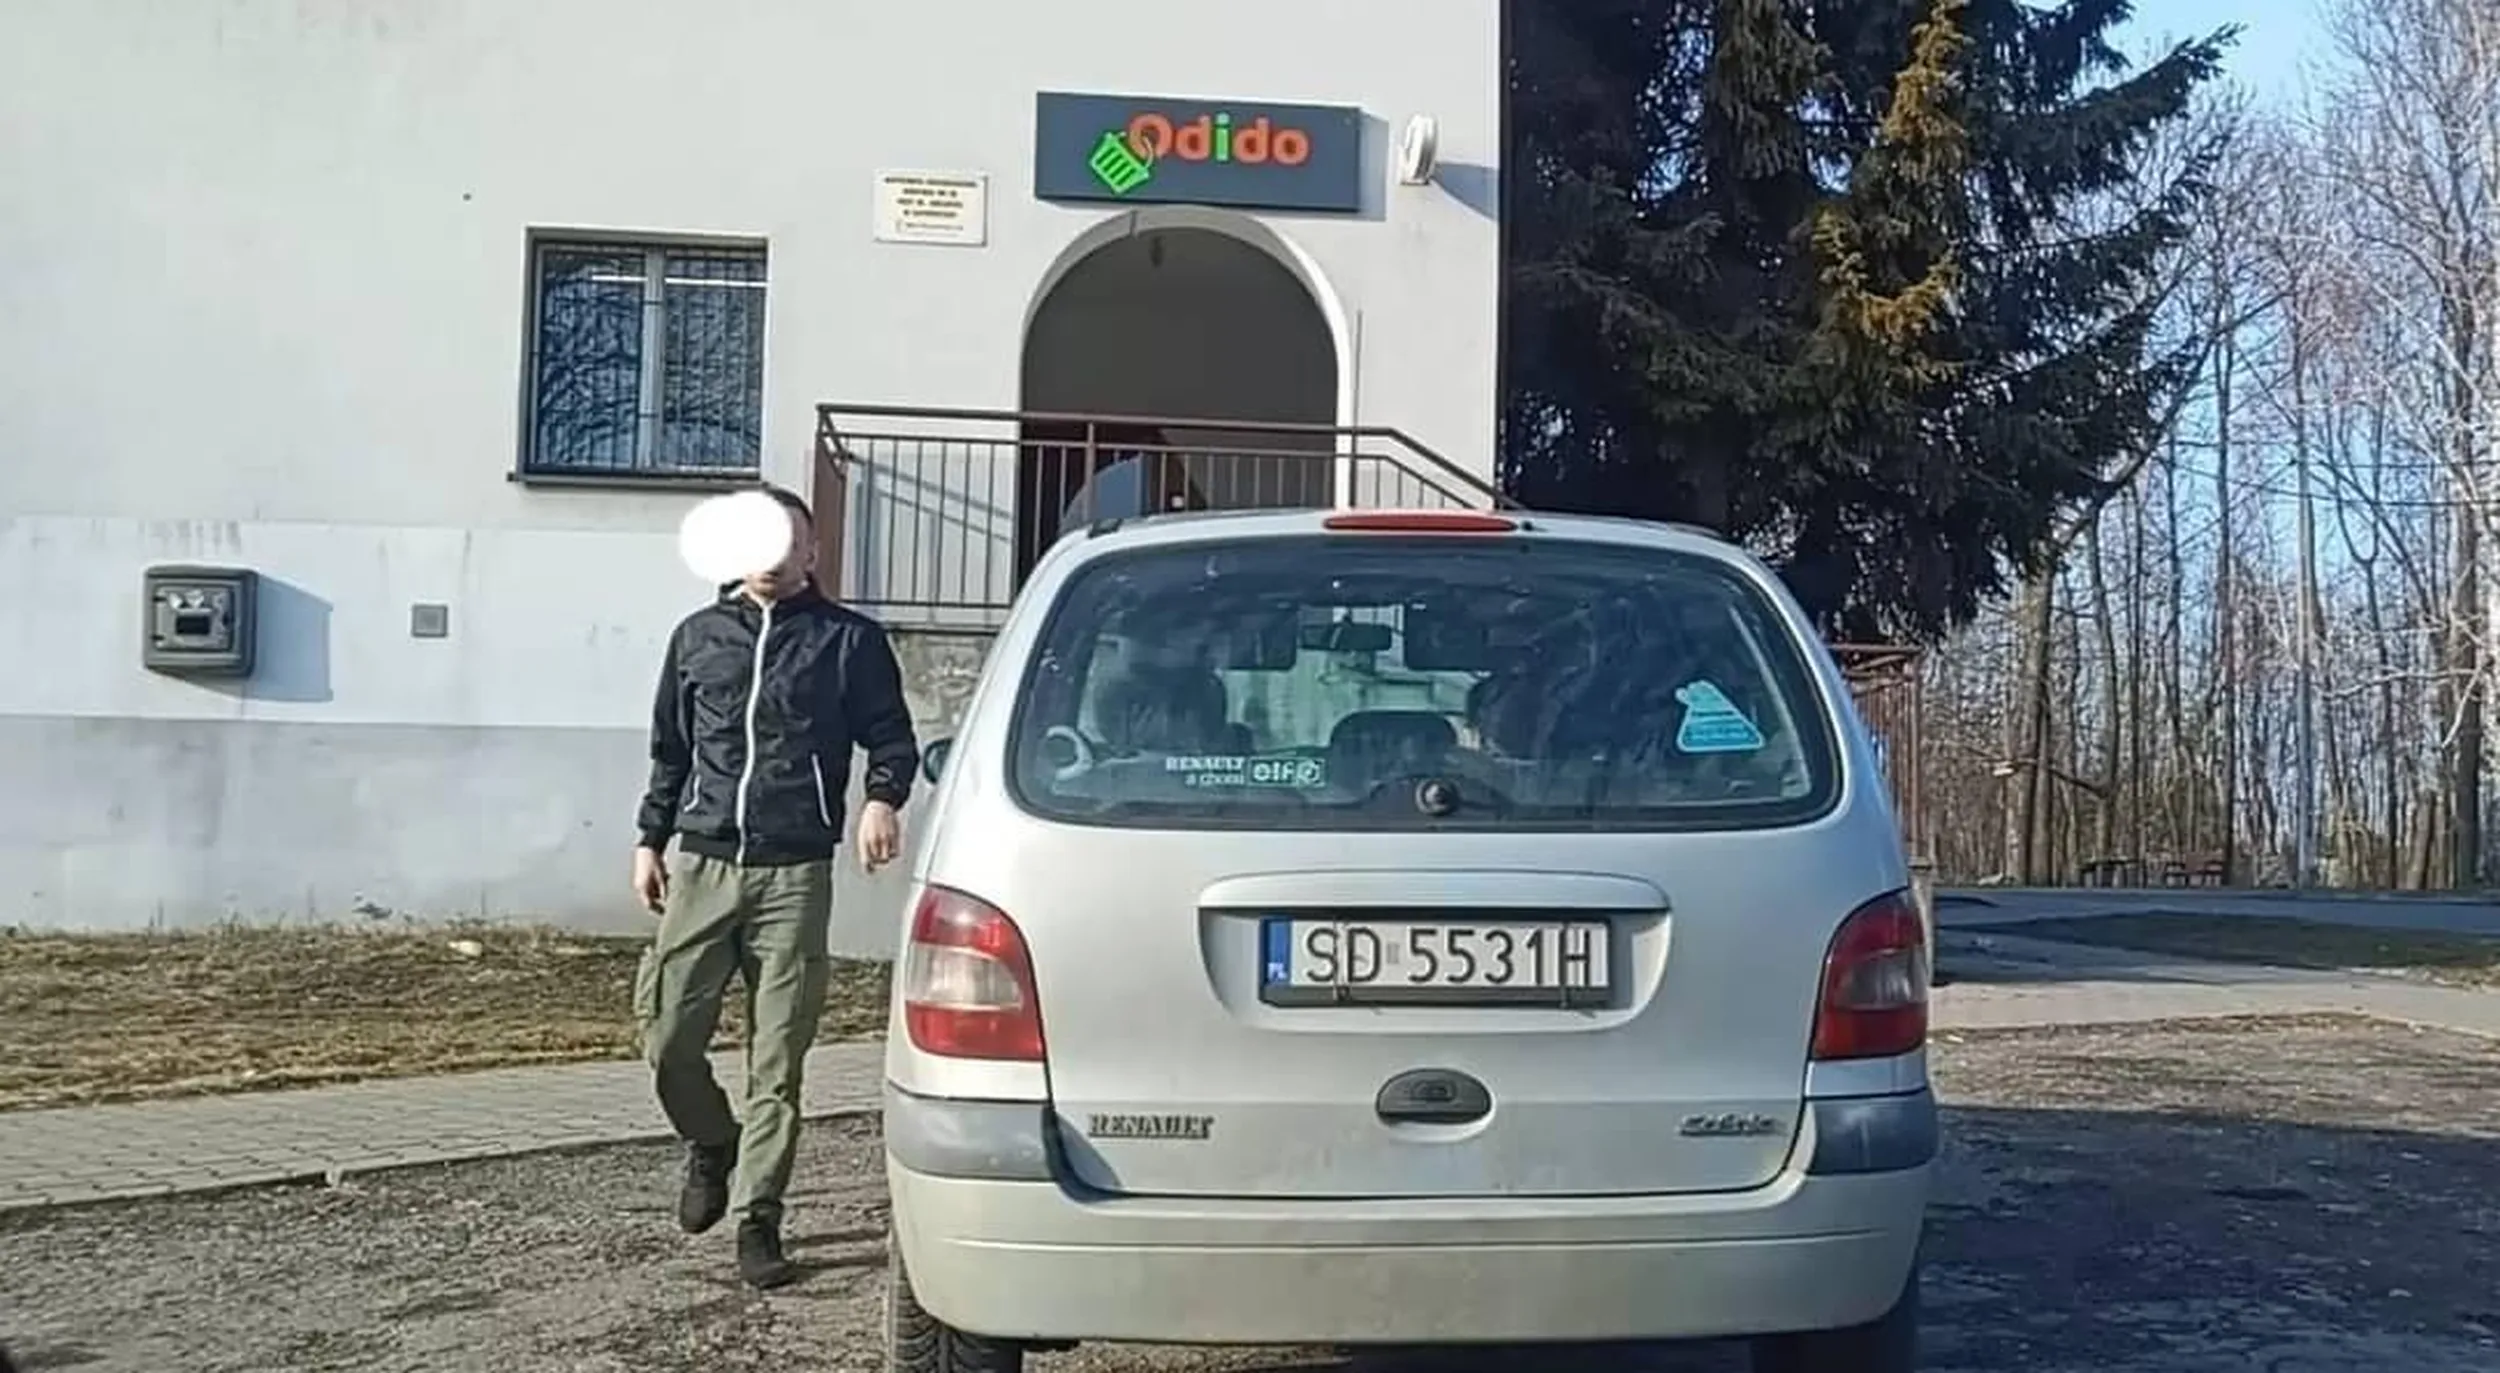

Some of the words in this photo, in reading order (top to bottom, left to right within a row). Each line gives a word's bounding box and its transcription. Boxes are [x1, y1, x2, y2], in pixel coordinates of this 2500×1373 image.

[1129, 112, 1310, 165] Odido
[1306, 926, 1381, 984] SD
[1408, 926, 1590, 986] 5531H
[1089, 1113, 1215, 1139] RENAULT
